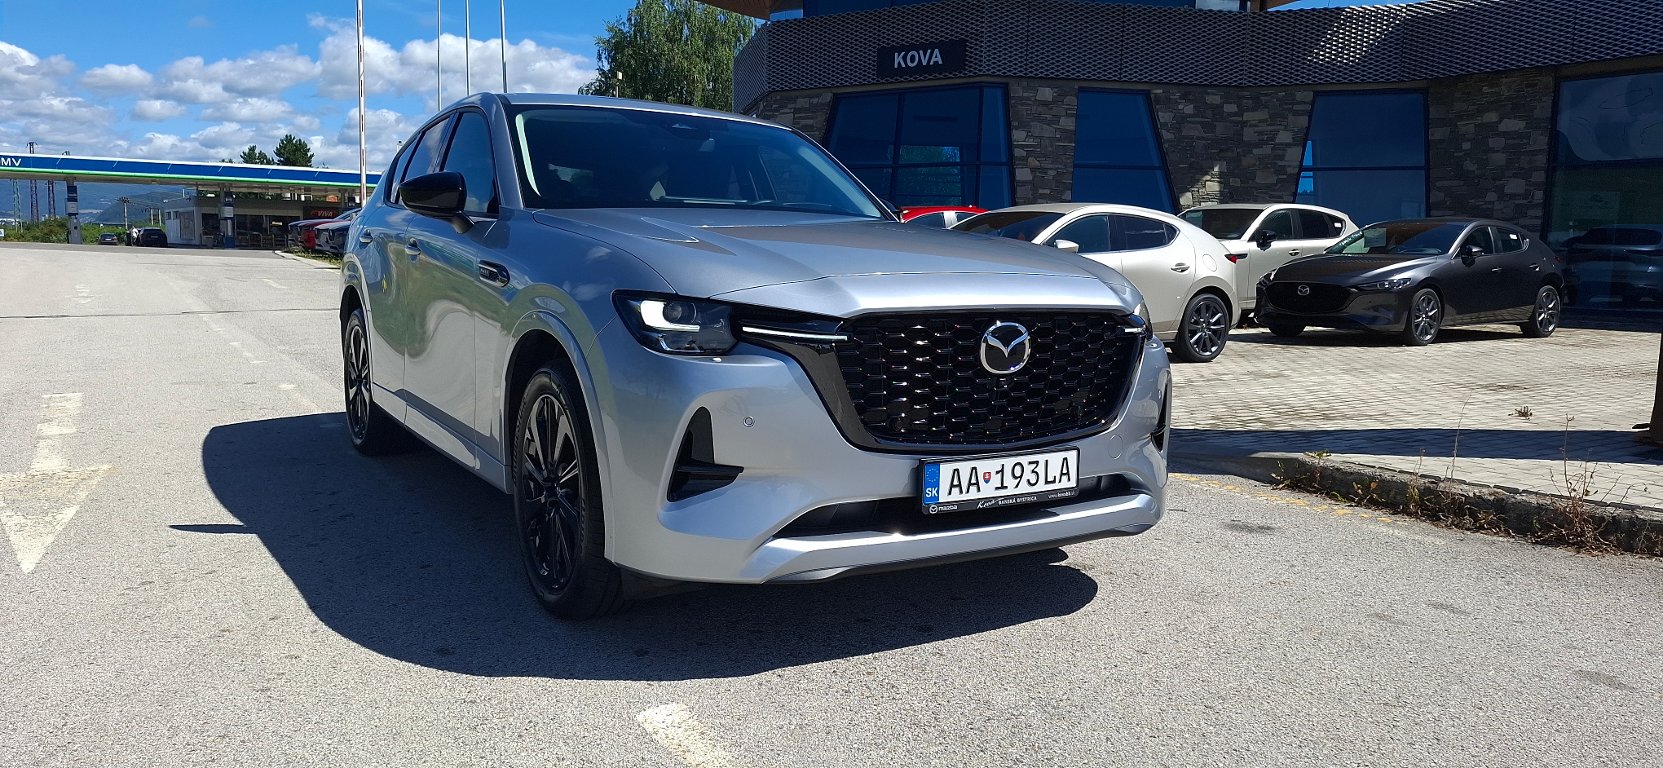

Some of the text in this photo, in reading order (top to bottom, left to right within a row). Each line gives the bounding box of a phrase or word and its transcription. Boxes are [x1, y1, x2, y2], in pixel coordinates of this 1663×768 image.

[894, 48, 943, 69] KOVA
[0, 157, 22, 166] MV
[947, 456, 1071, 496] AA 193LA
[925, 487, 938, 498] SK
